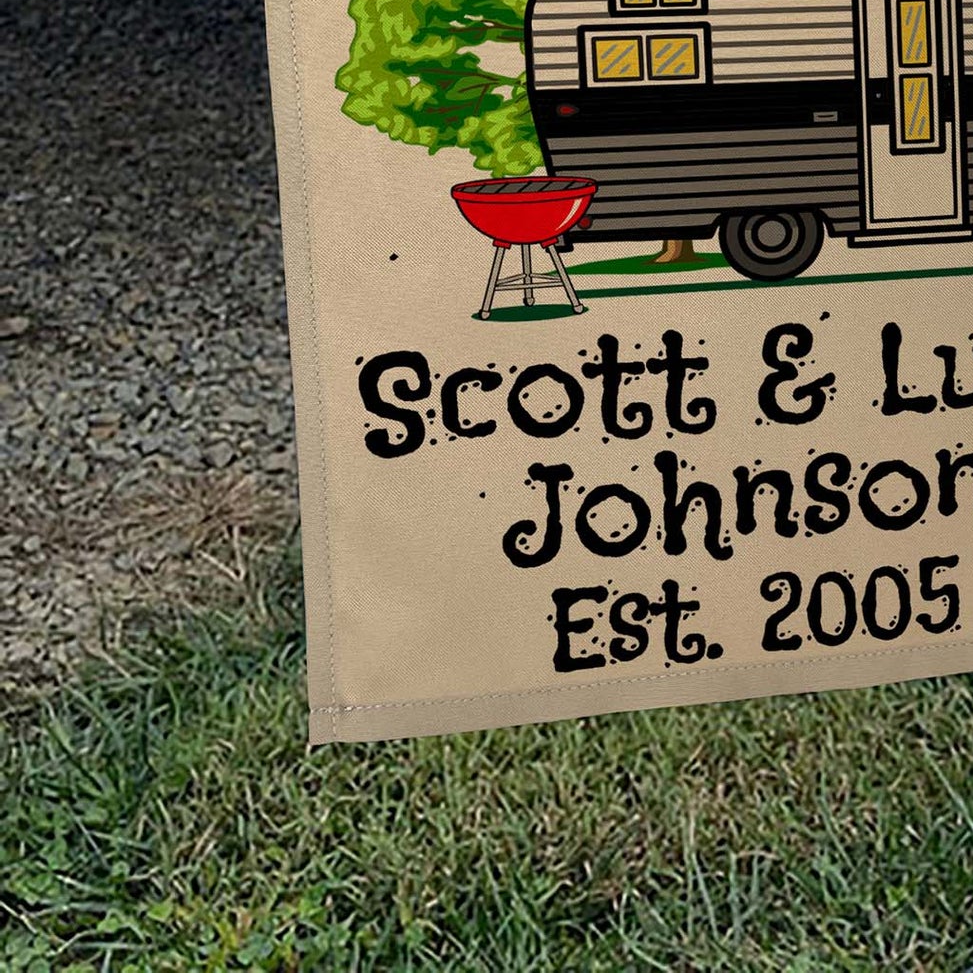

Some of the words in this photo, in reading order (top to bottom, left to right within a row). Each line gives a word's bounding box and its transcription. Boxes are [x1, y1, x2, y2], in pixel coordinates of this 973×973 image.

[355, 330, 717, 459] Scott
[756, 313, 837, 426] &
[548, 578, 723, 672] Est.
[760, 555, 963, 651] 2005
